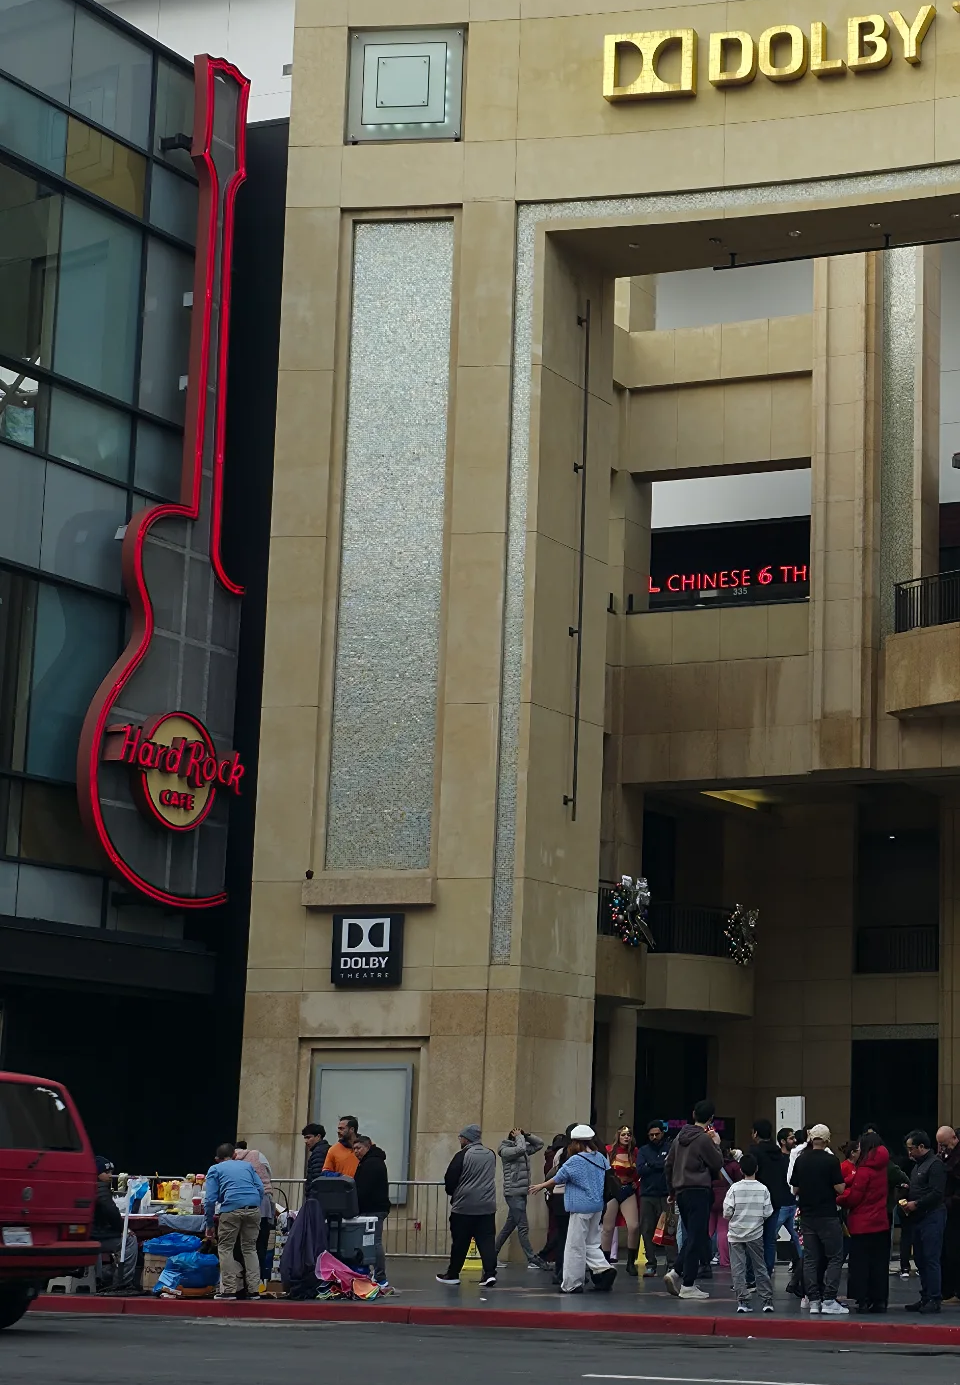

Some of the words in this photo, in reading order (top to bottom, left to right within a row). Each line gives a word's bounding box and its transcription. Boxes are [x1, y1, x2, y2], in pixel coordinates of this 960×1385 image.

[708, 4, 937, 88] DOLBY
[667, 569, 751, 592] CHINESE
[758, 565, 773, 585] 6
[780, 565, 810, 582] TH
[733, 587, 748, 596] 335
[119, 723, 187, 774] Hard
[185, 738, 246, 796] Rock
[160, 789, 195, 811] CAFE
[340, 956, 389, 969] DOLBY
